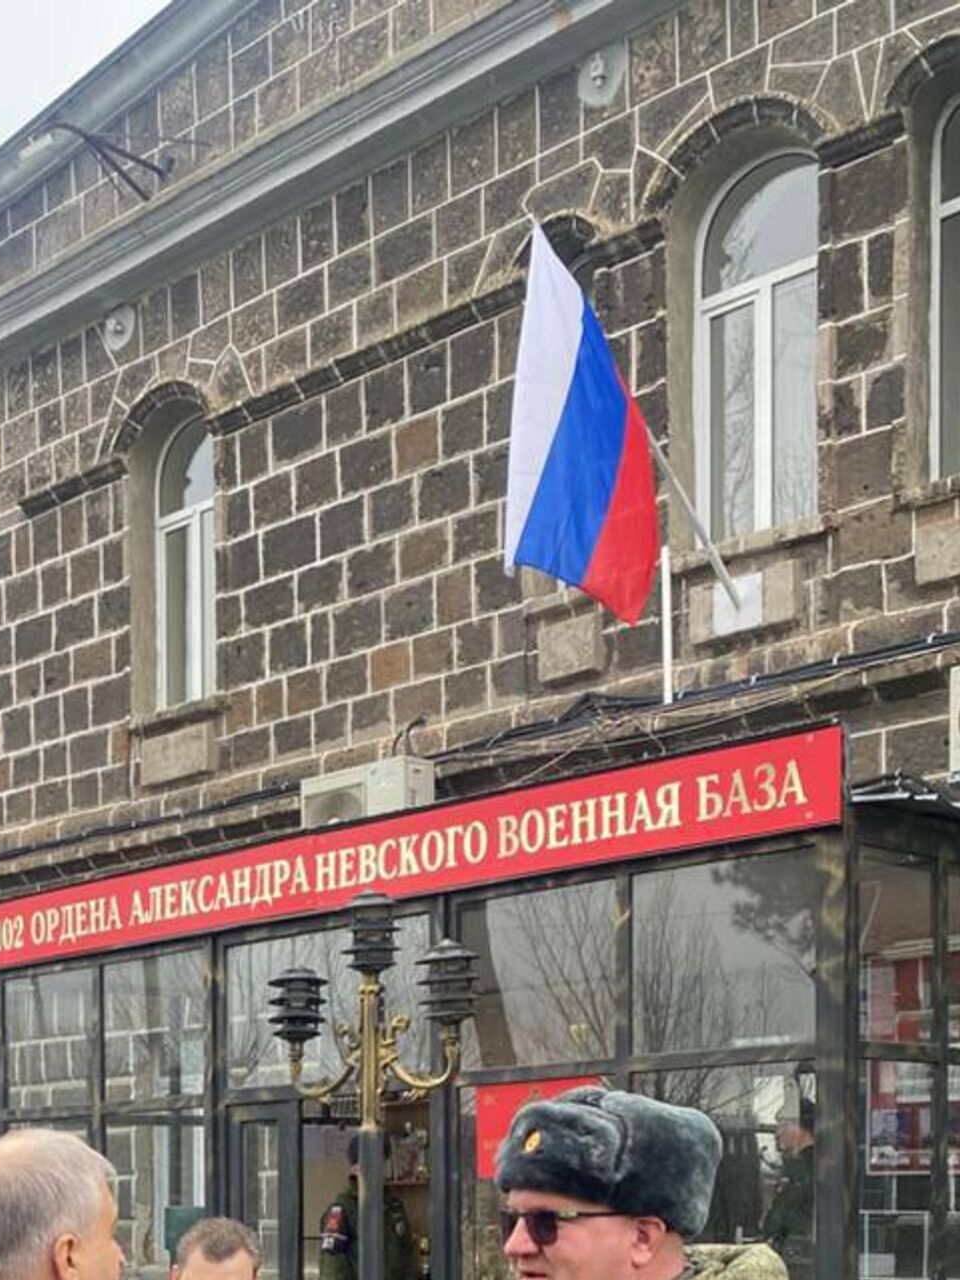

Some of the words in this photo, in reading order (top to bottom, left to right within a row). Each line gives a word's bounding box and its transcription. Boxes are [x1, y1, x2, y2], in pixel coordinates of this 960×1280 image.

[30, 897, 123, 945] ОРДЕНА
[129, 855, 311, 926] АЛЕКСАНДРА
[315, 821, 488, 891] НЕВСКОГО
[497, 782, 682, 858] ВОЕННАЯ
[696, 759, 809, 822] БАЗА
